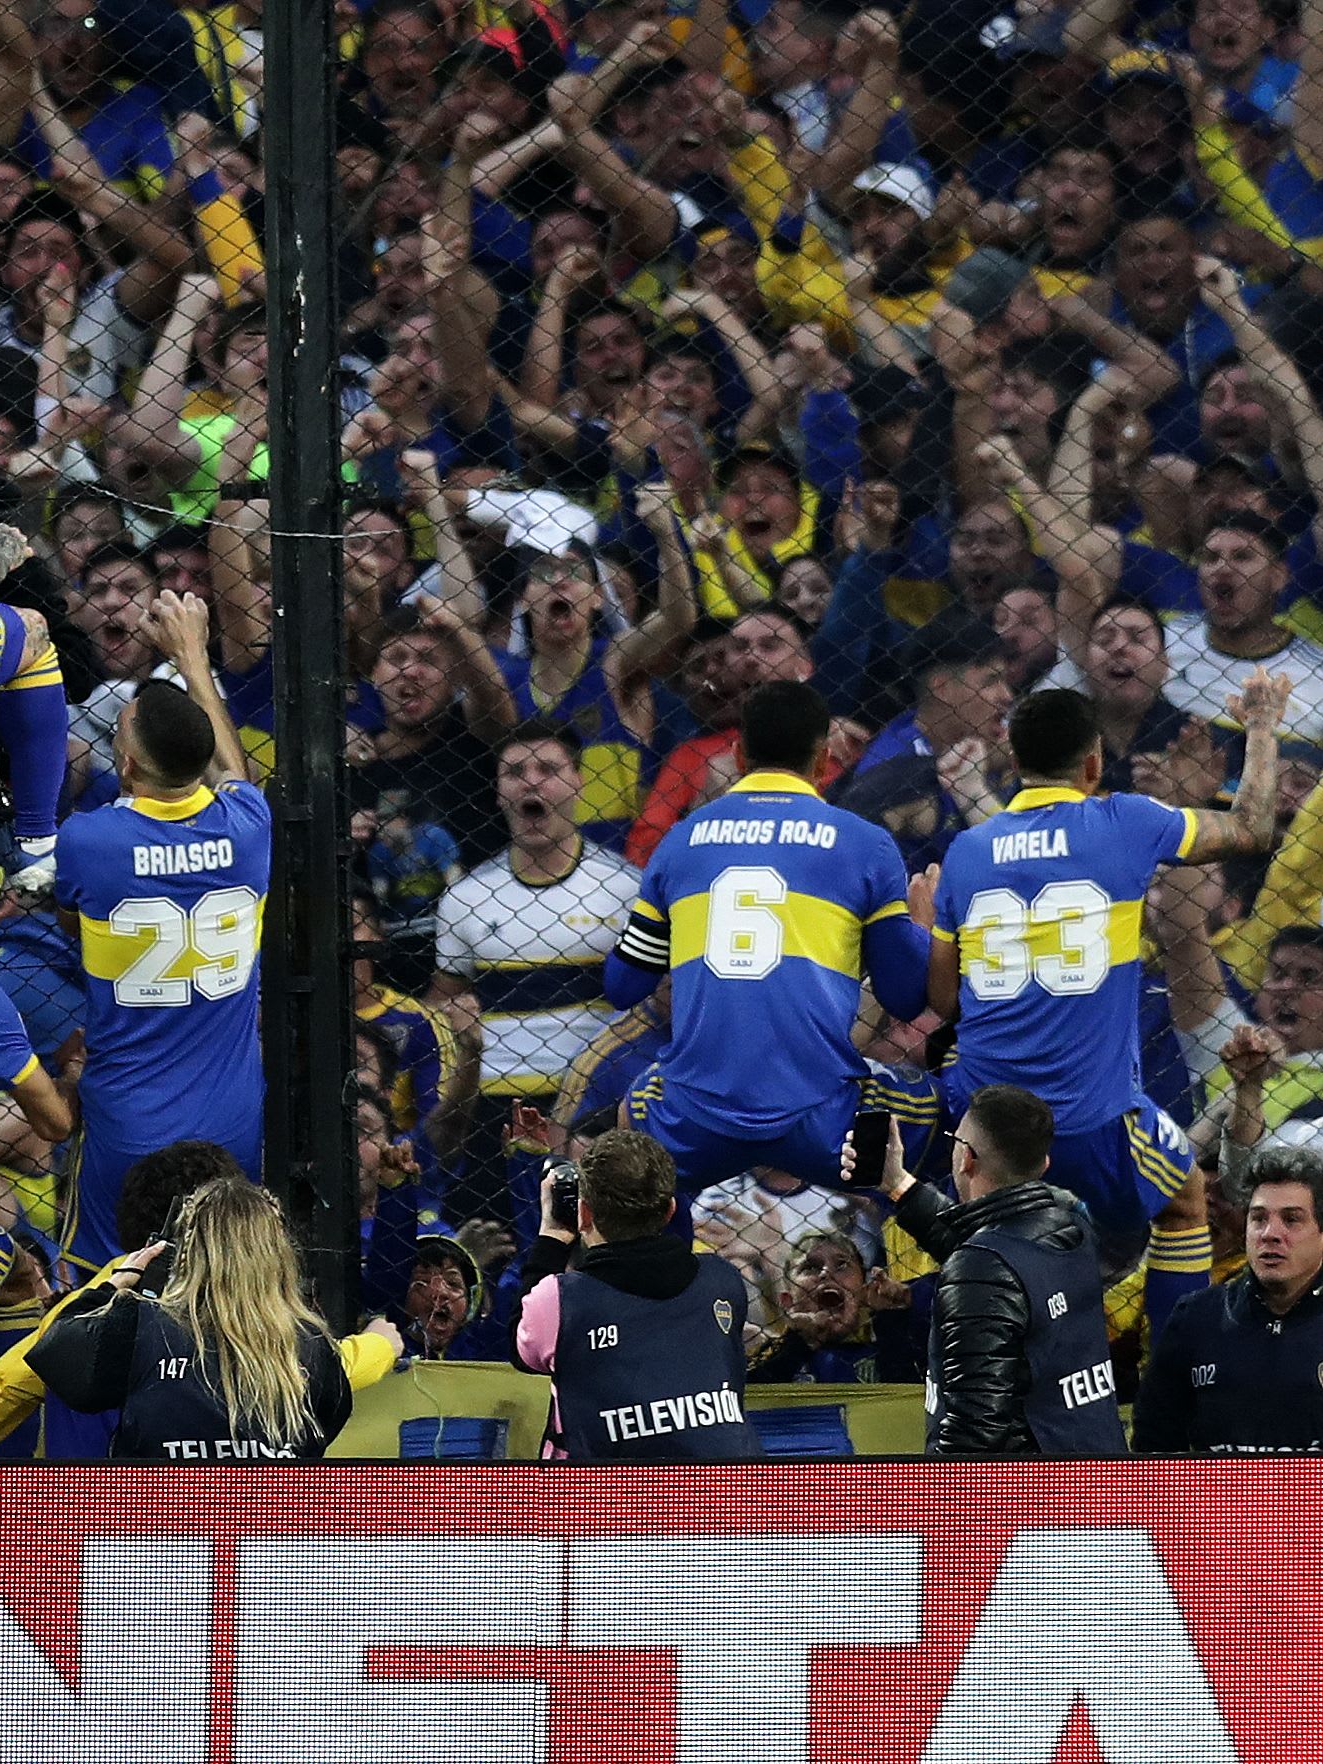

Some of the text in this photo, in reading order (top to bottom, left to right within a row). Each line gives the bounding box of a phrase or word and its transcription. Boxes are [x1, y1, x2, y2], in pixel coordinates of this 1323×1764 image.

[690, 819, 837, 849] MARCOS ROJO
[992, 828, 1069, 864] VARELA
[133, 839, 233, 876] BRIASCO
[704, 866, 788, 980] 6
[965, 879, 1110, 1000] 33
[109, 885, 259, 1006] 29
[1047, 1292, 1068, 1320] 039
[587, 1325, 618, 1350] 129
[158, 1358, 188, 1380] 147
[1192, 1364, 1216, 1387] 002
[599, 1382, 744, 1442] TELEVISIÓN
